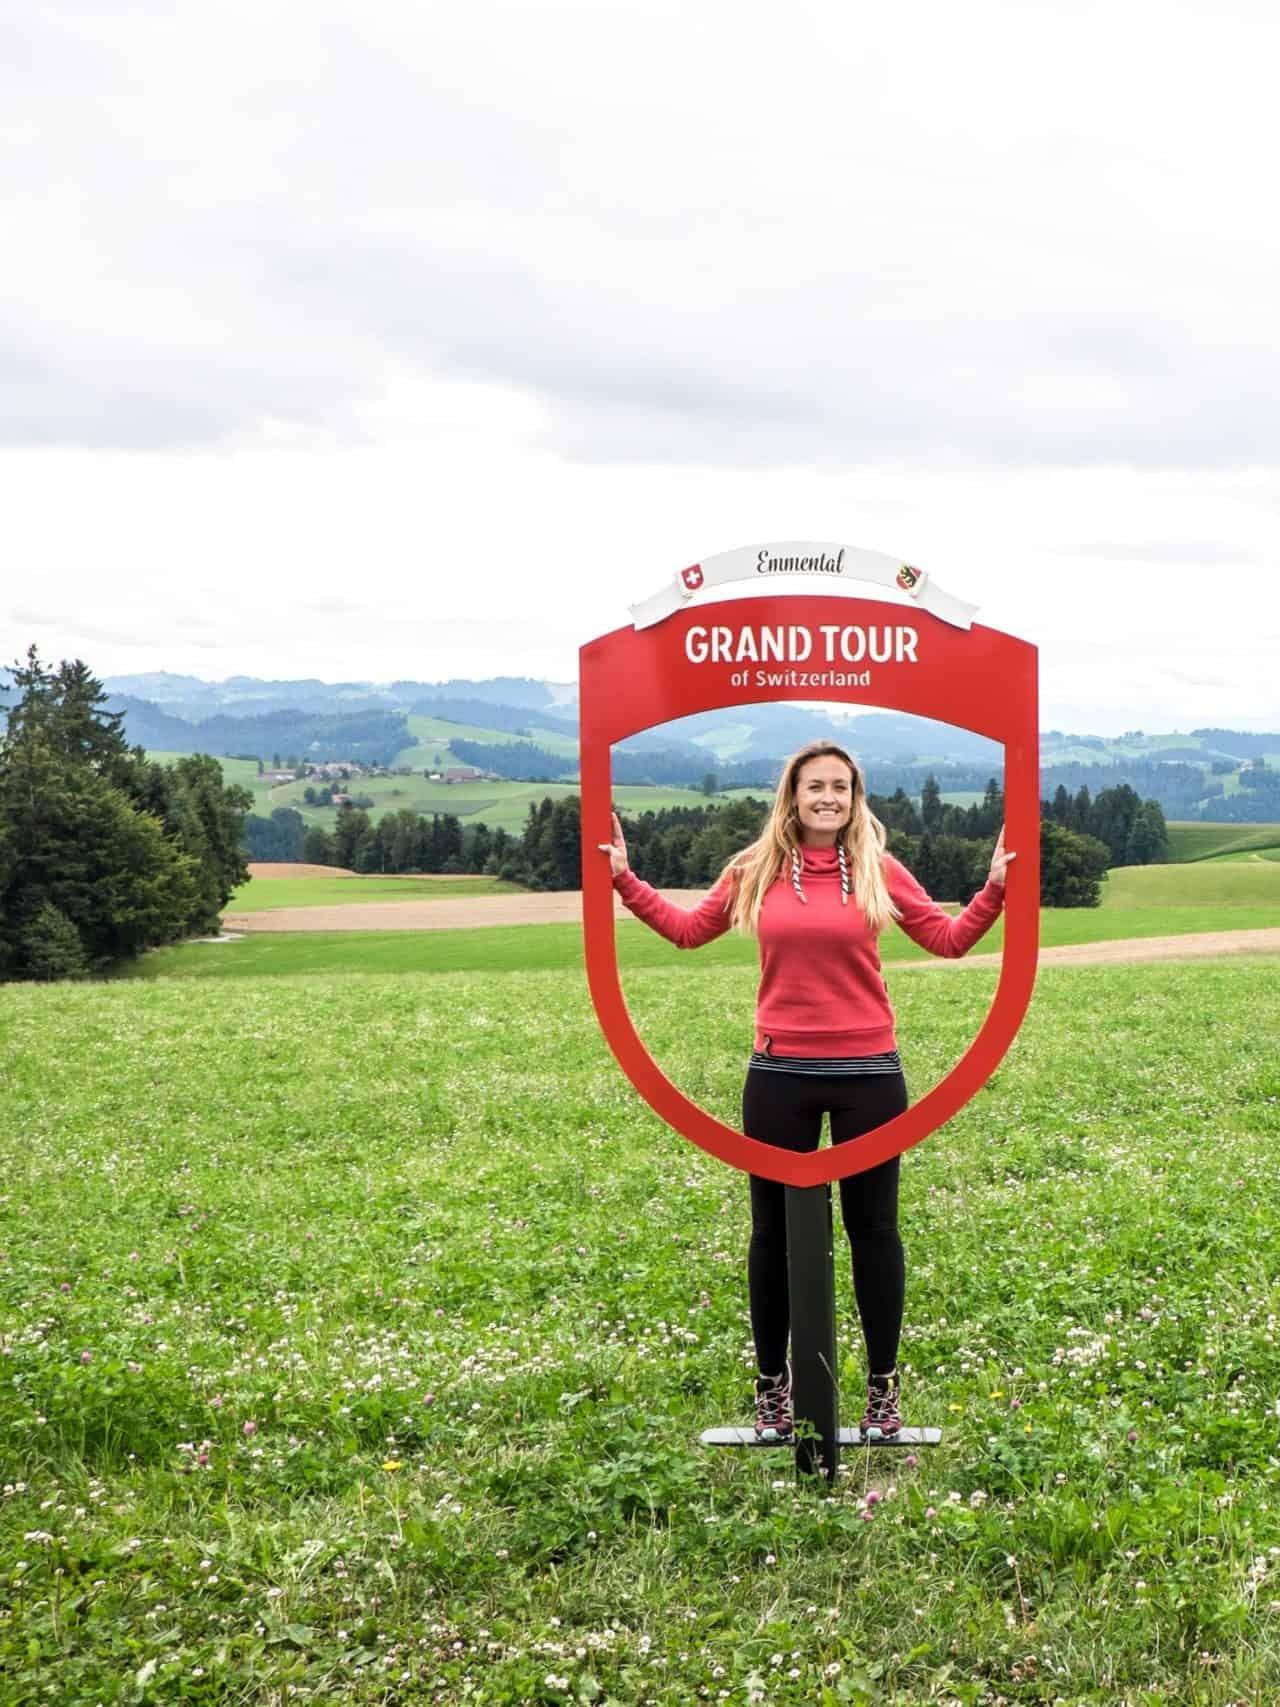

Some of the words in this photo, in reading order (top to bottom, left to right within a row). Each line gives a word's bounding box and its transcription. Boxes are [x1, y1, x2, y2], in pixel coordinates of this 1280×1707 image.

[756, 548, 845, 574] Emmental
[685, 625, 813, 664] GRAND
[819, 625, 919, 663] TOUR
[731, 669, 749, 687] of
[756, 669, 871, 687] Switzerland
